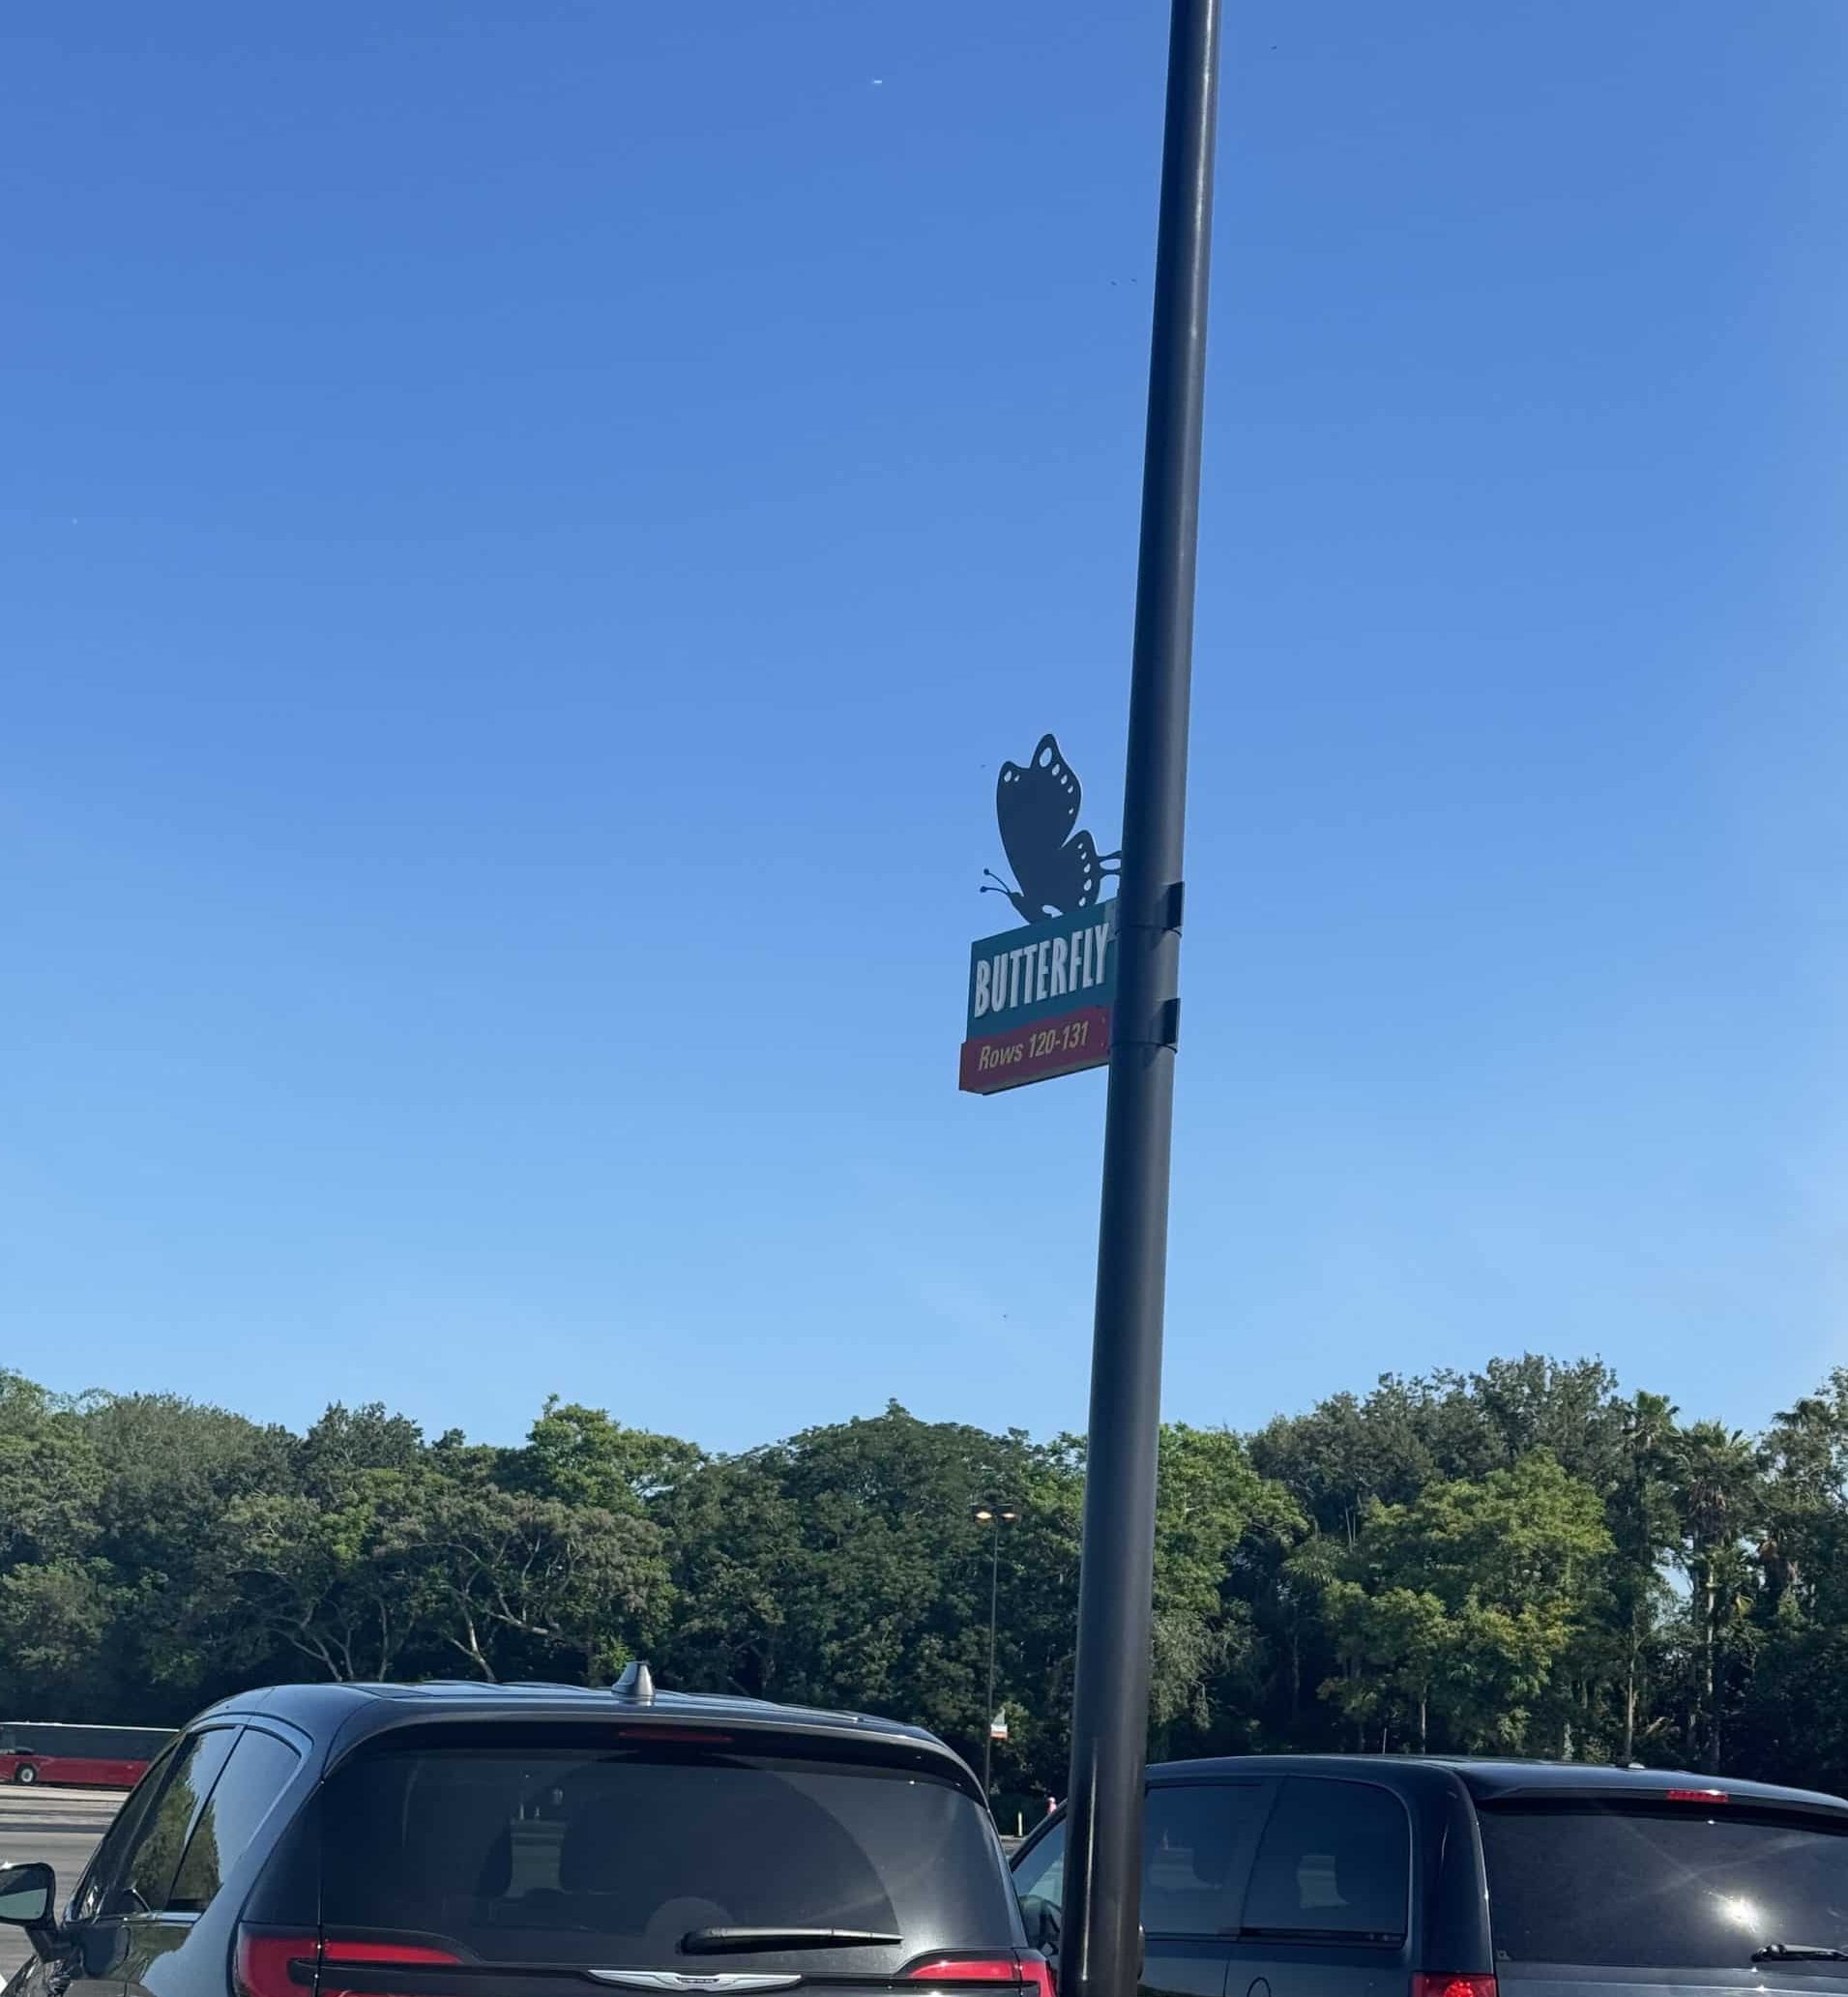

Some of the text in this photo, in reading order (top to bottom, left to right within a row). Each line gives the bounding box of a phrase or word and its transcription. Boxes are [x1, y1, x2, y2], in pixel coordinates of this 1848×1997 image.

[975, 923, 1109, 1018] BUTTERFLY
[979, 1020, 1089, 1072] Rows 120-131
